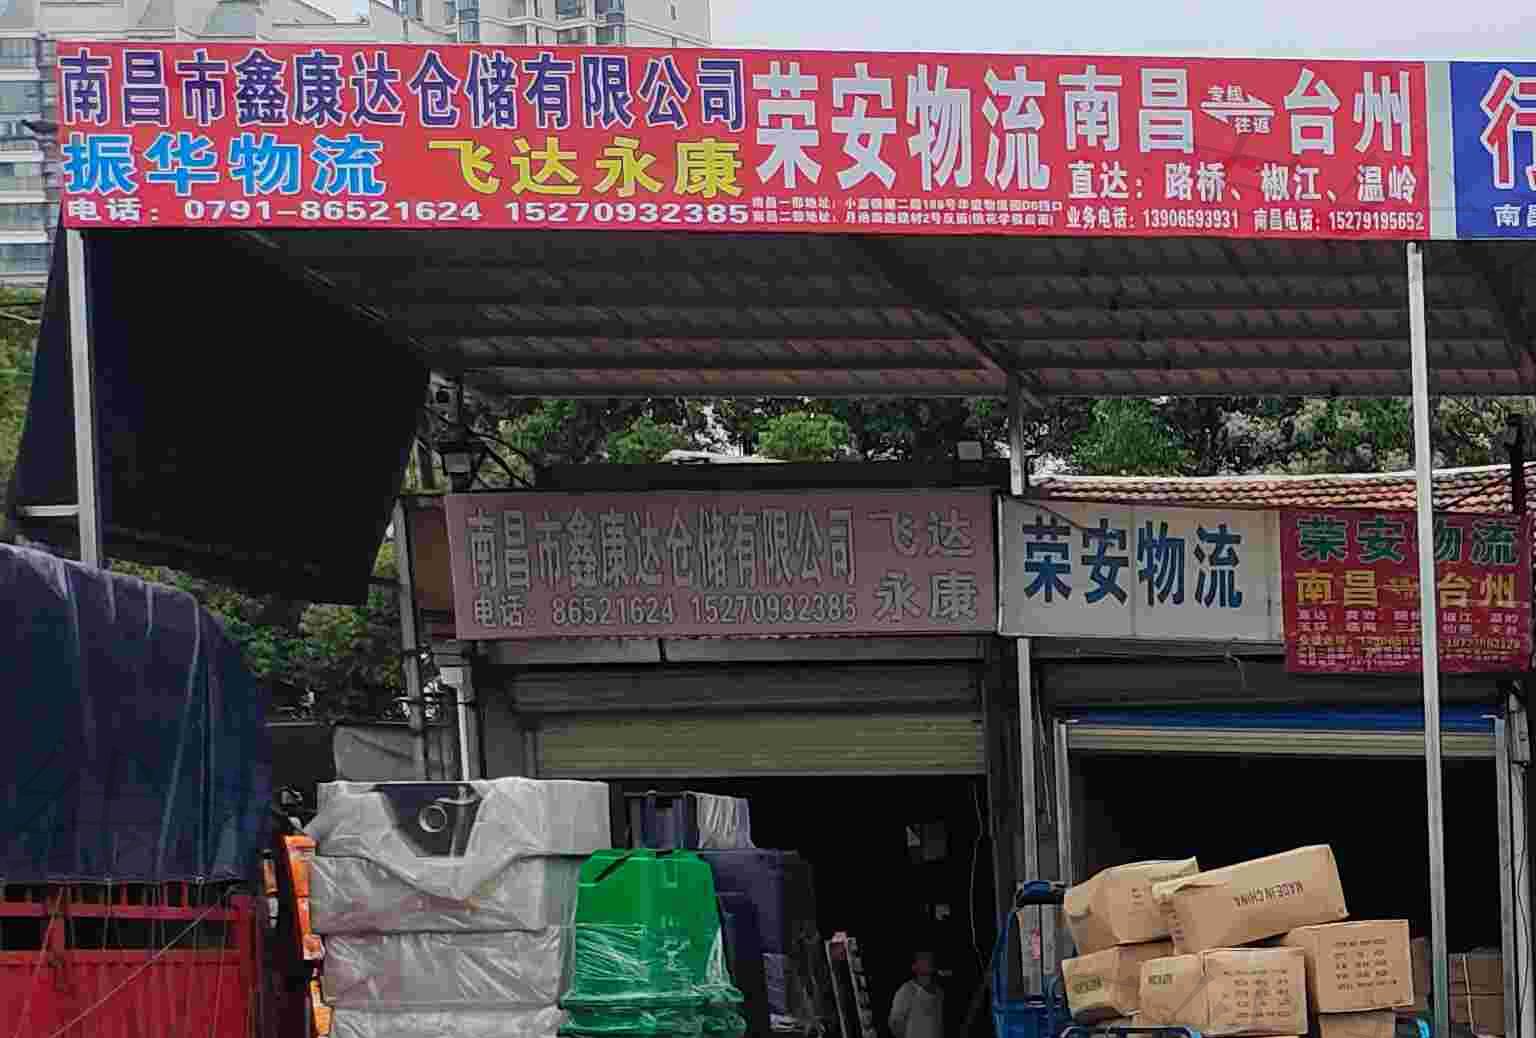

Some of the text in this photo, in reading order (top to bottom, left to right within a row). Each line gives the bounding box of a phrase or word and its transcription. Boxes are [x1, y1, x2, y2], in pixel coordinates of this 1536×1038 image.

[58, 47, 747, 132] 南昌市鑫康达仓储有限公司
[1058, 65, 1412, 157] 南昌 台州
[752, 61, 1050, 192] 荣安物流
[61, 132, 744, 199] 振华物流 飞达永康
[184, 201, 482, 223] 0791-86521624
[504, 202, 749, 224] 15270932385
[466, 509, 856, 589] 南昌市鑫康达仓储有限公司
[867, 509, 973, 559] 飞达
[1022, 517, 1245, 610] 荣安物流
[552, 593, 675, 626] 86521624
[691, 594, 857, 625] 15270932385
[874, 569, 978, 621] 永康
[1295, 569, 1516, 609] 南昌 台州
